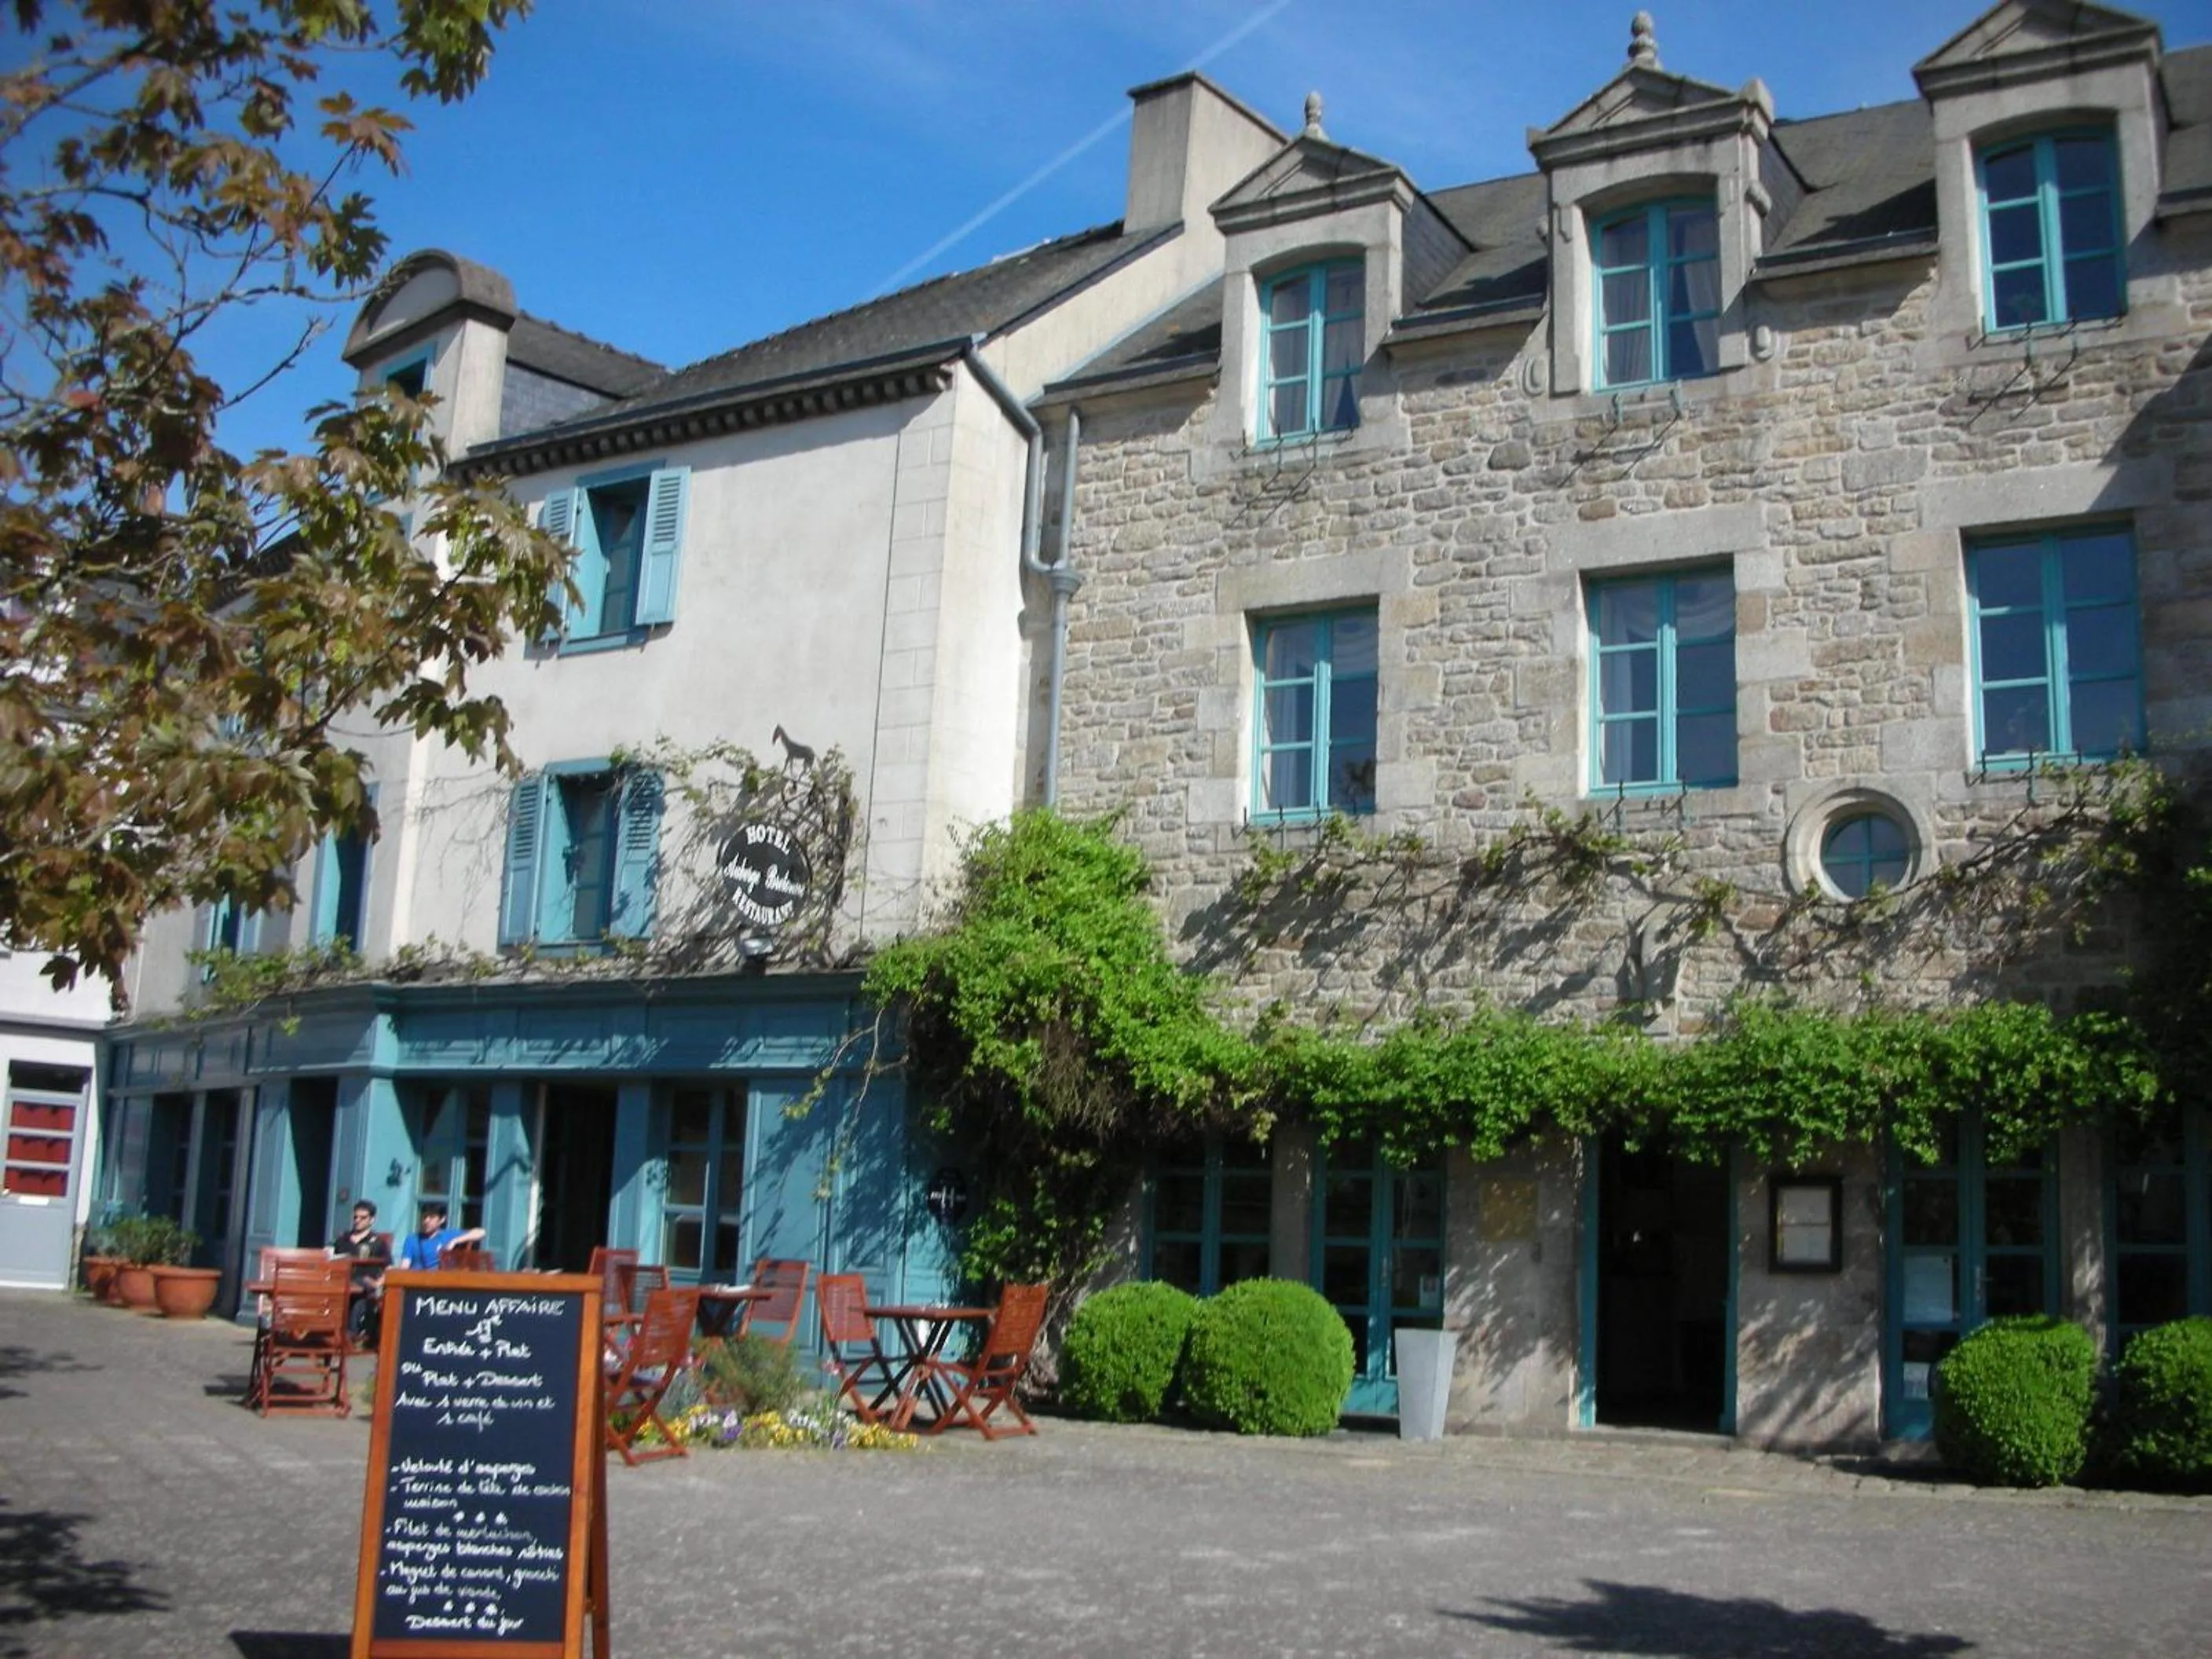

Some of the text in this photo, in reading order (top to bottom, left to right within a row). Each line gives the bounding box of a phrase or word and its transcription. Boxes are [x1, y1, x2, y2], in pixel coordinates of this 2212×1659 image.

[745, 824, 791, 855] HOTEL
[416, 1296, 477, 1316] MENU
[495, 1339, 532, 1358] Plat
[422, 1370, 459, 1388] Plat
[457, 1479, 476, 1495] de
